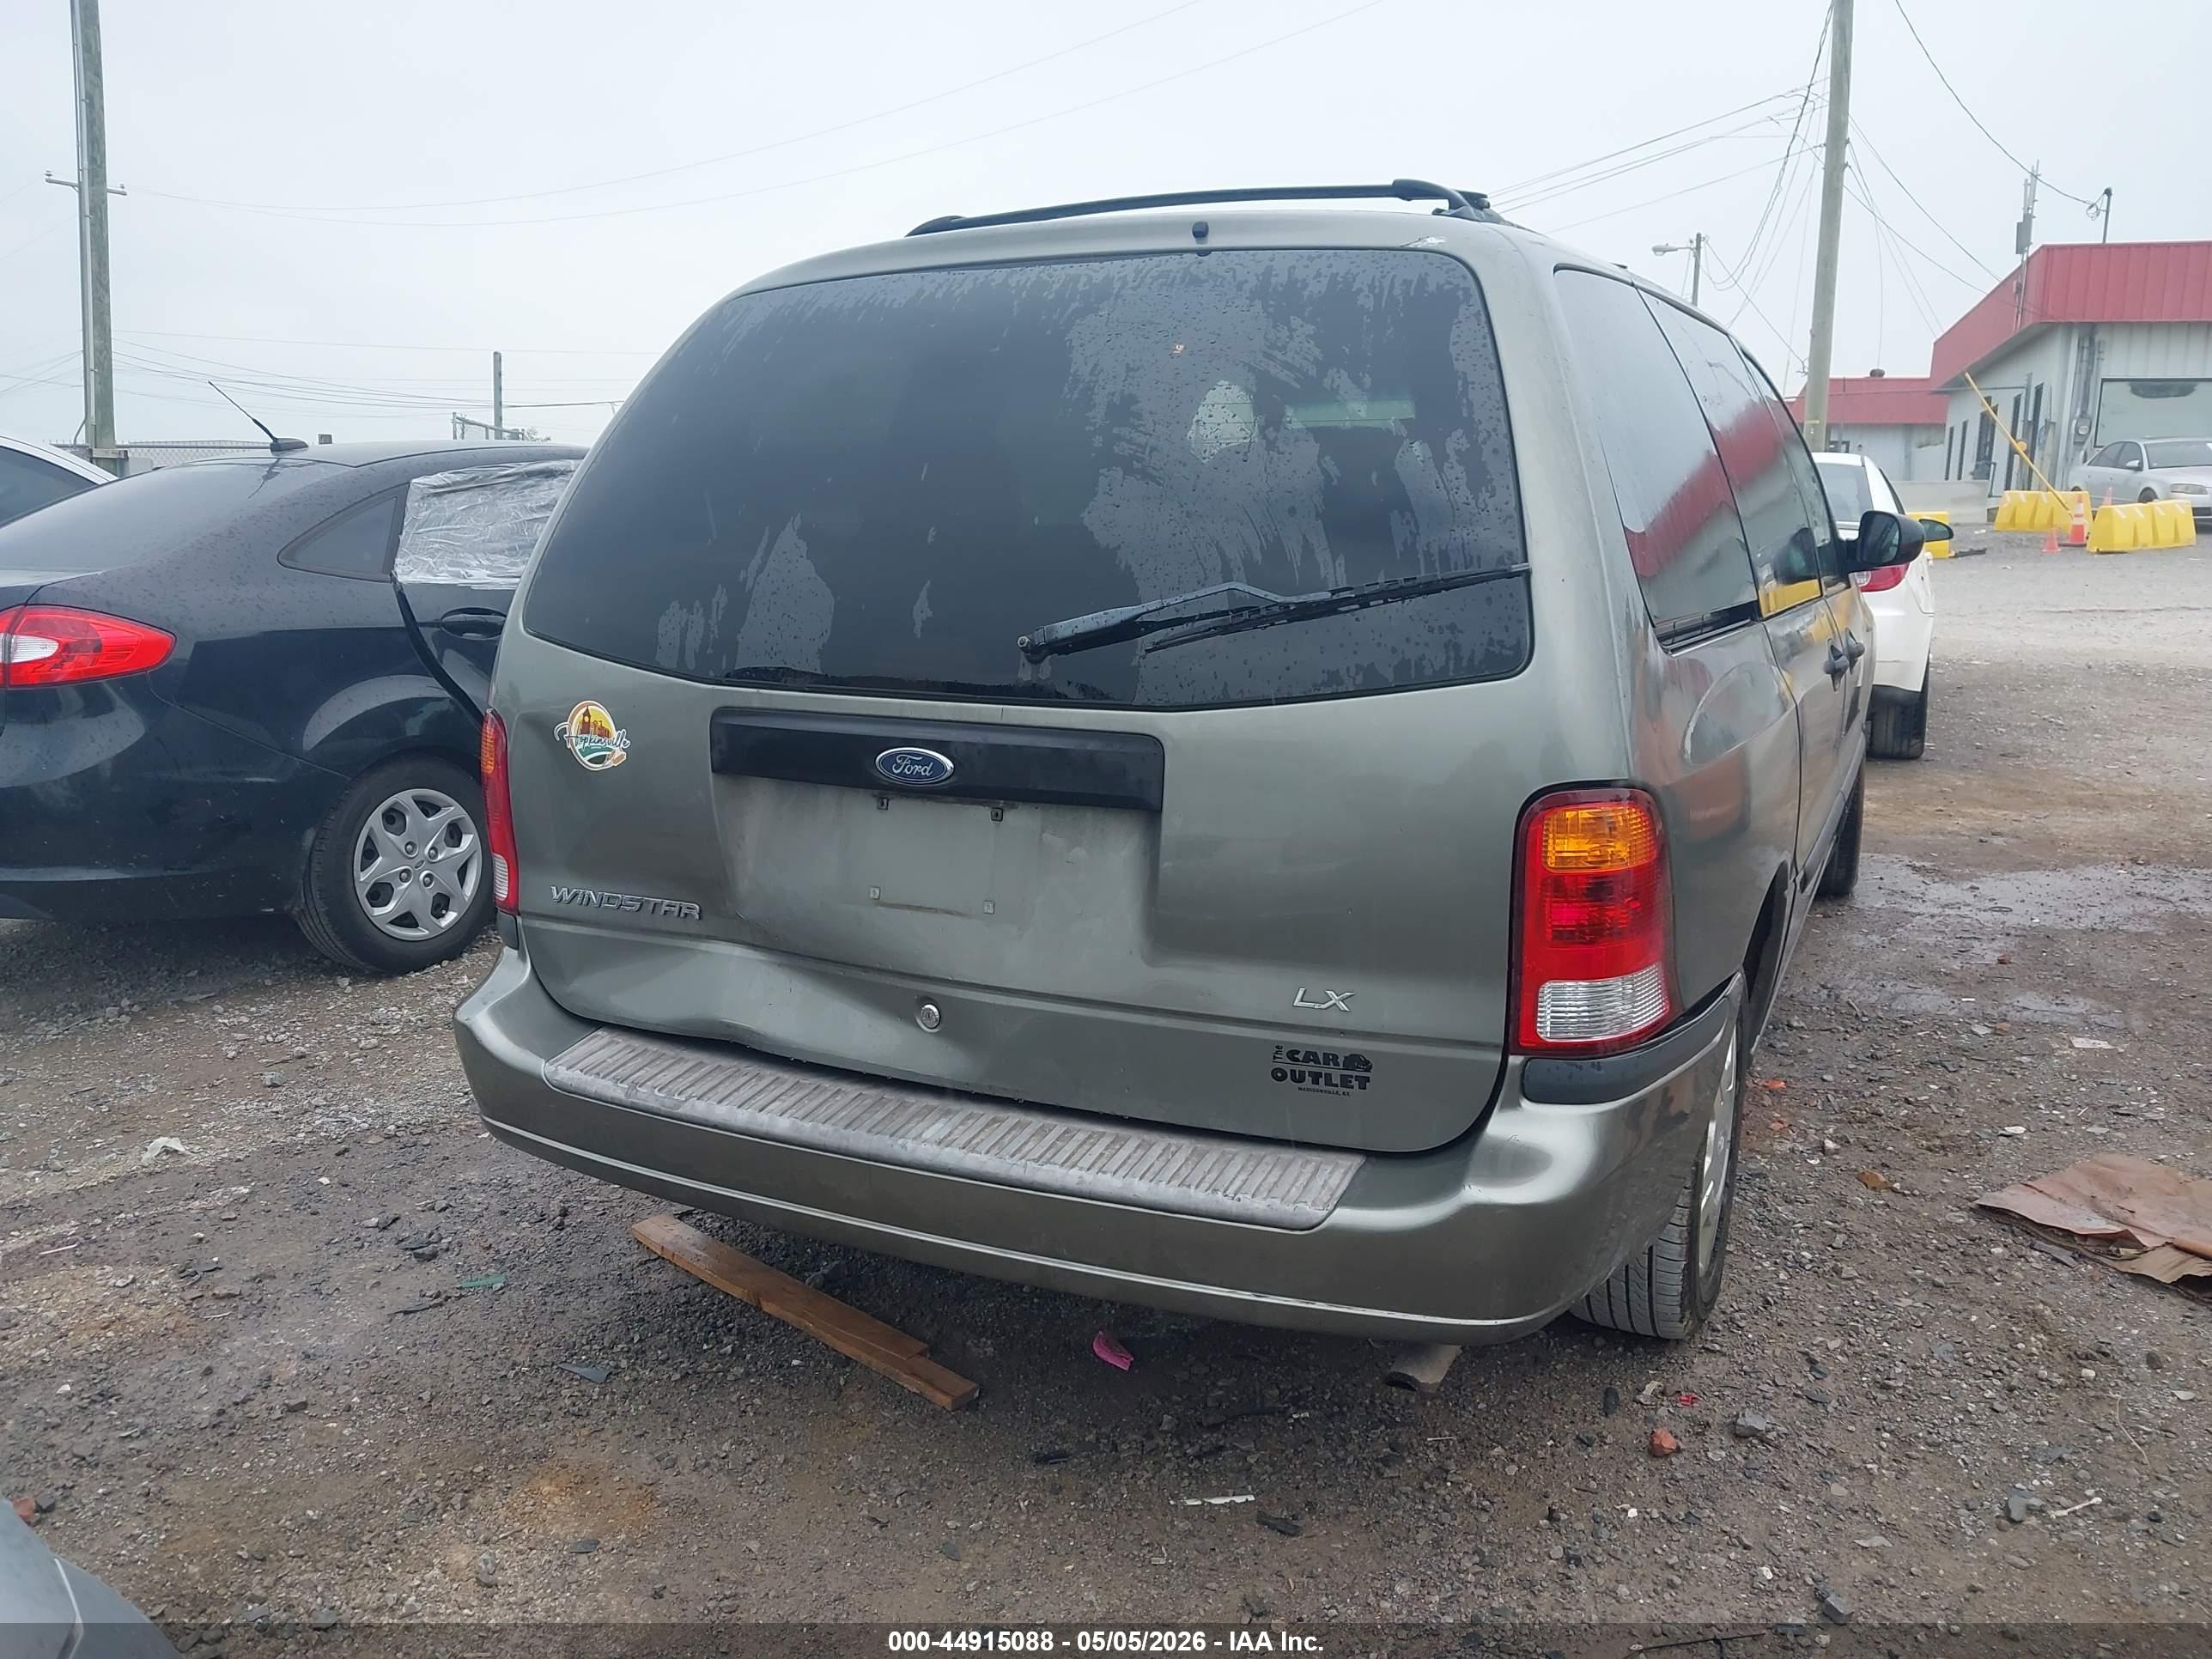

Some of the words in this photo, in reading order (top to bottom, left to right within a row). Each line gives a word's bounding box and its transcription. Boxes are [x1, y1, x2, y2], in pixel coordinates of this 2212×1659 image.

[892, 754, 933, 775] Ford
[550, 885, 701, 920] WINDSTAR
[1292, 987, 1358, 1012] LX
[1273, 1044, 1283, 1060] The
[1286, 1049, 1340, 1066] CAR
[1271, 1067, 1370, 1090] OUTLET
